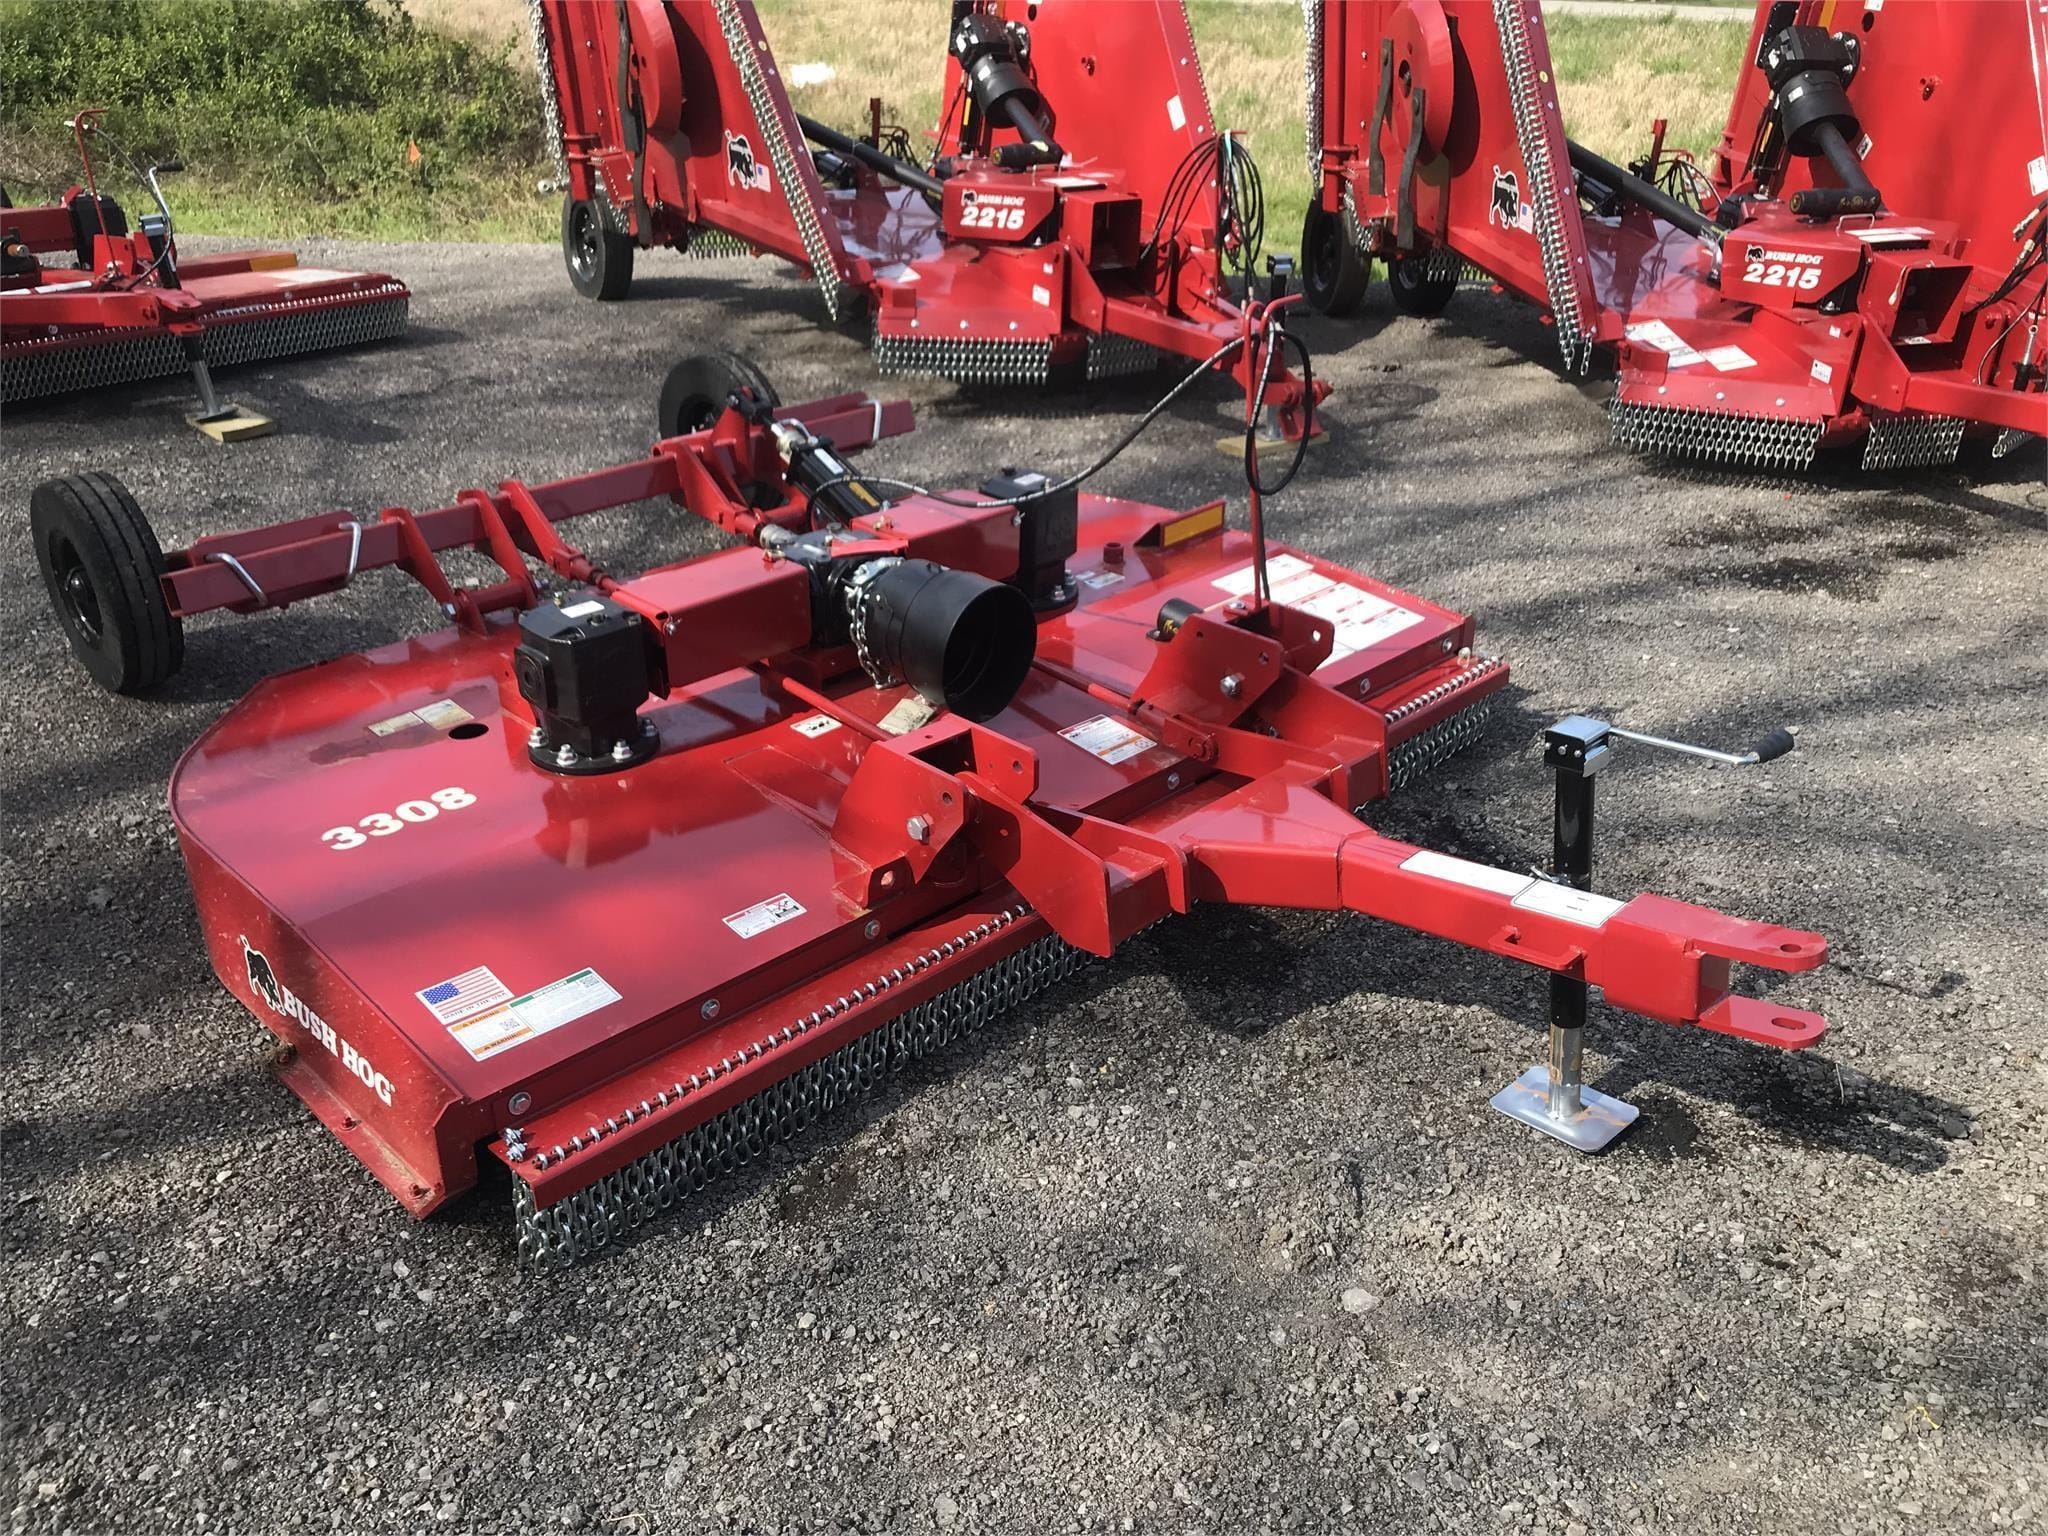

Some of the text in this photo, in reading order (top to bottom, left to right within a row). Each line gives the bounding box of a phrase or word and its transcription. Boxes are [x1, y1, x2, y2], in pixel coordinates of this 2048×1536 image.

[978, 193, 1025, 207] BUSH HOG
[960, 205, 1025, 230] 2215
[1765, 250, 1823, 264] BUSH HOG
[1742, 262, 1822, 290] 2215
[321, 786, 478, 851] 3308
[281, 984, 392, 1107] BUSH HOG
